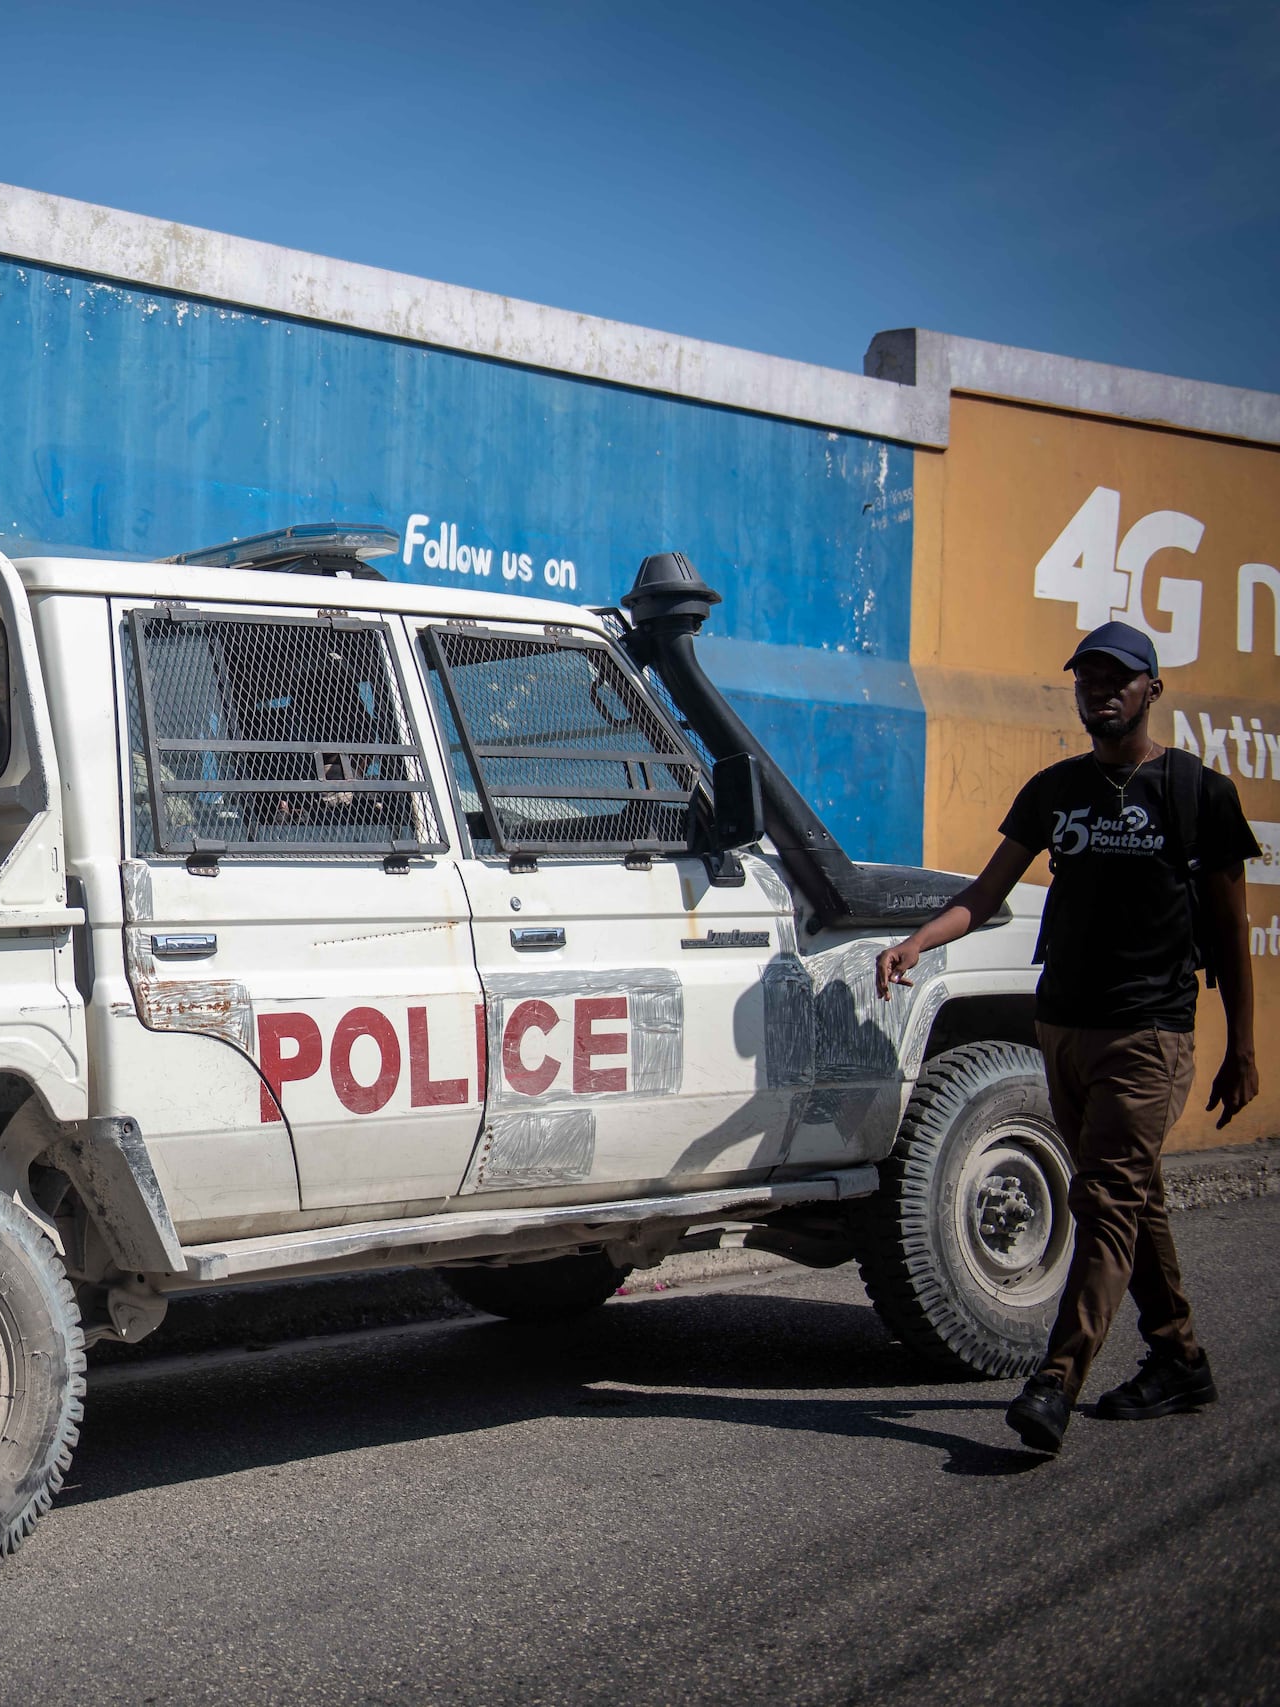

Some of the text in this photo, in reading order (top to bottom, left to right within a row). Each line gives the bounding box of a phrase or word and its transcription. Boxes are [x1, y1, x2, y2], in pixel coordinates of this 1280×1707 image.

[402, 513, 576, 590] Follow us on
[1034, 486, 1206, 668] 4G
[1052, 806, 1091, 855] 25
[1090, 816, 1124, 832] Jou
[257, 996, 628, 1123] POLICE
